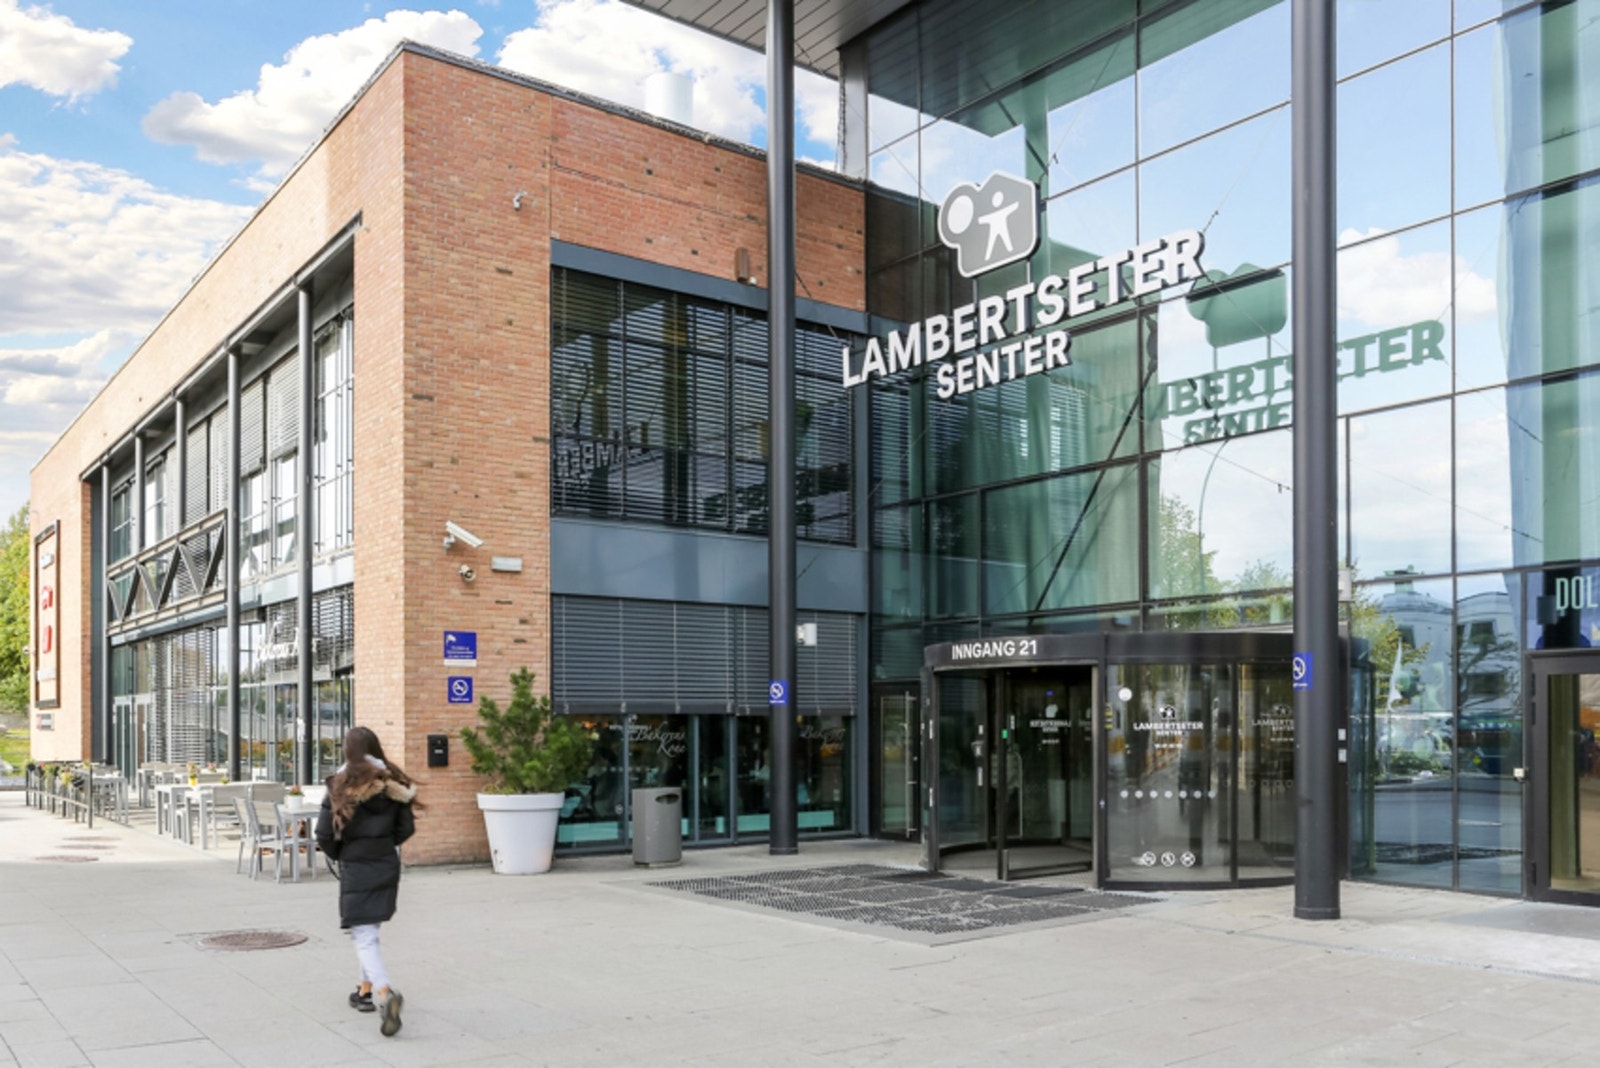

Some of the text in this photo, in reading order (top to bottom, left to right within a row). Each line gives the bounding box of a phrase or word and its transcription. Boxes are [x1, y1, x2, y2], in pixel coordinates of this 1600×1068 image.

[842, 229, 1205, 388] LAMBERTSETER
[936, 330, 1072, 400] SENTER
[952, 639, 1037, 660] INNGANG 21
[1133, 721, 1204, 731] LAMBERTSETER
